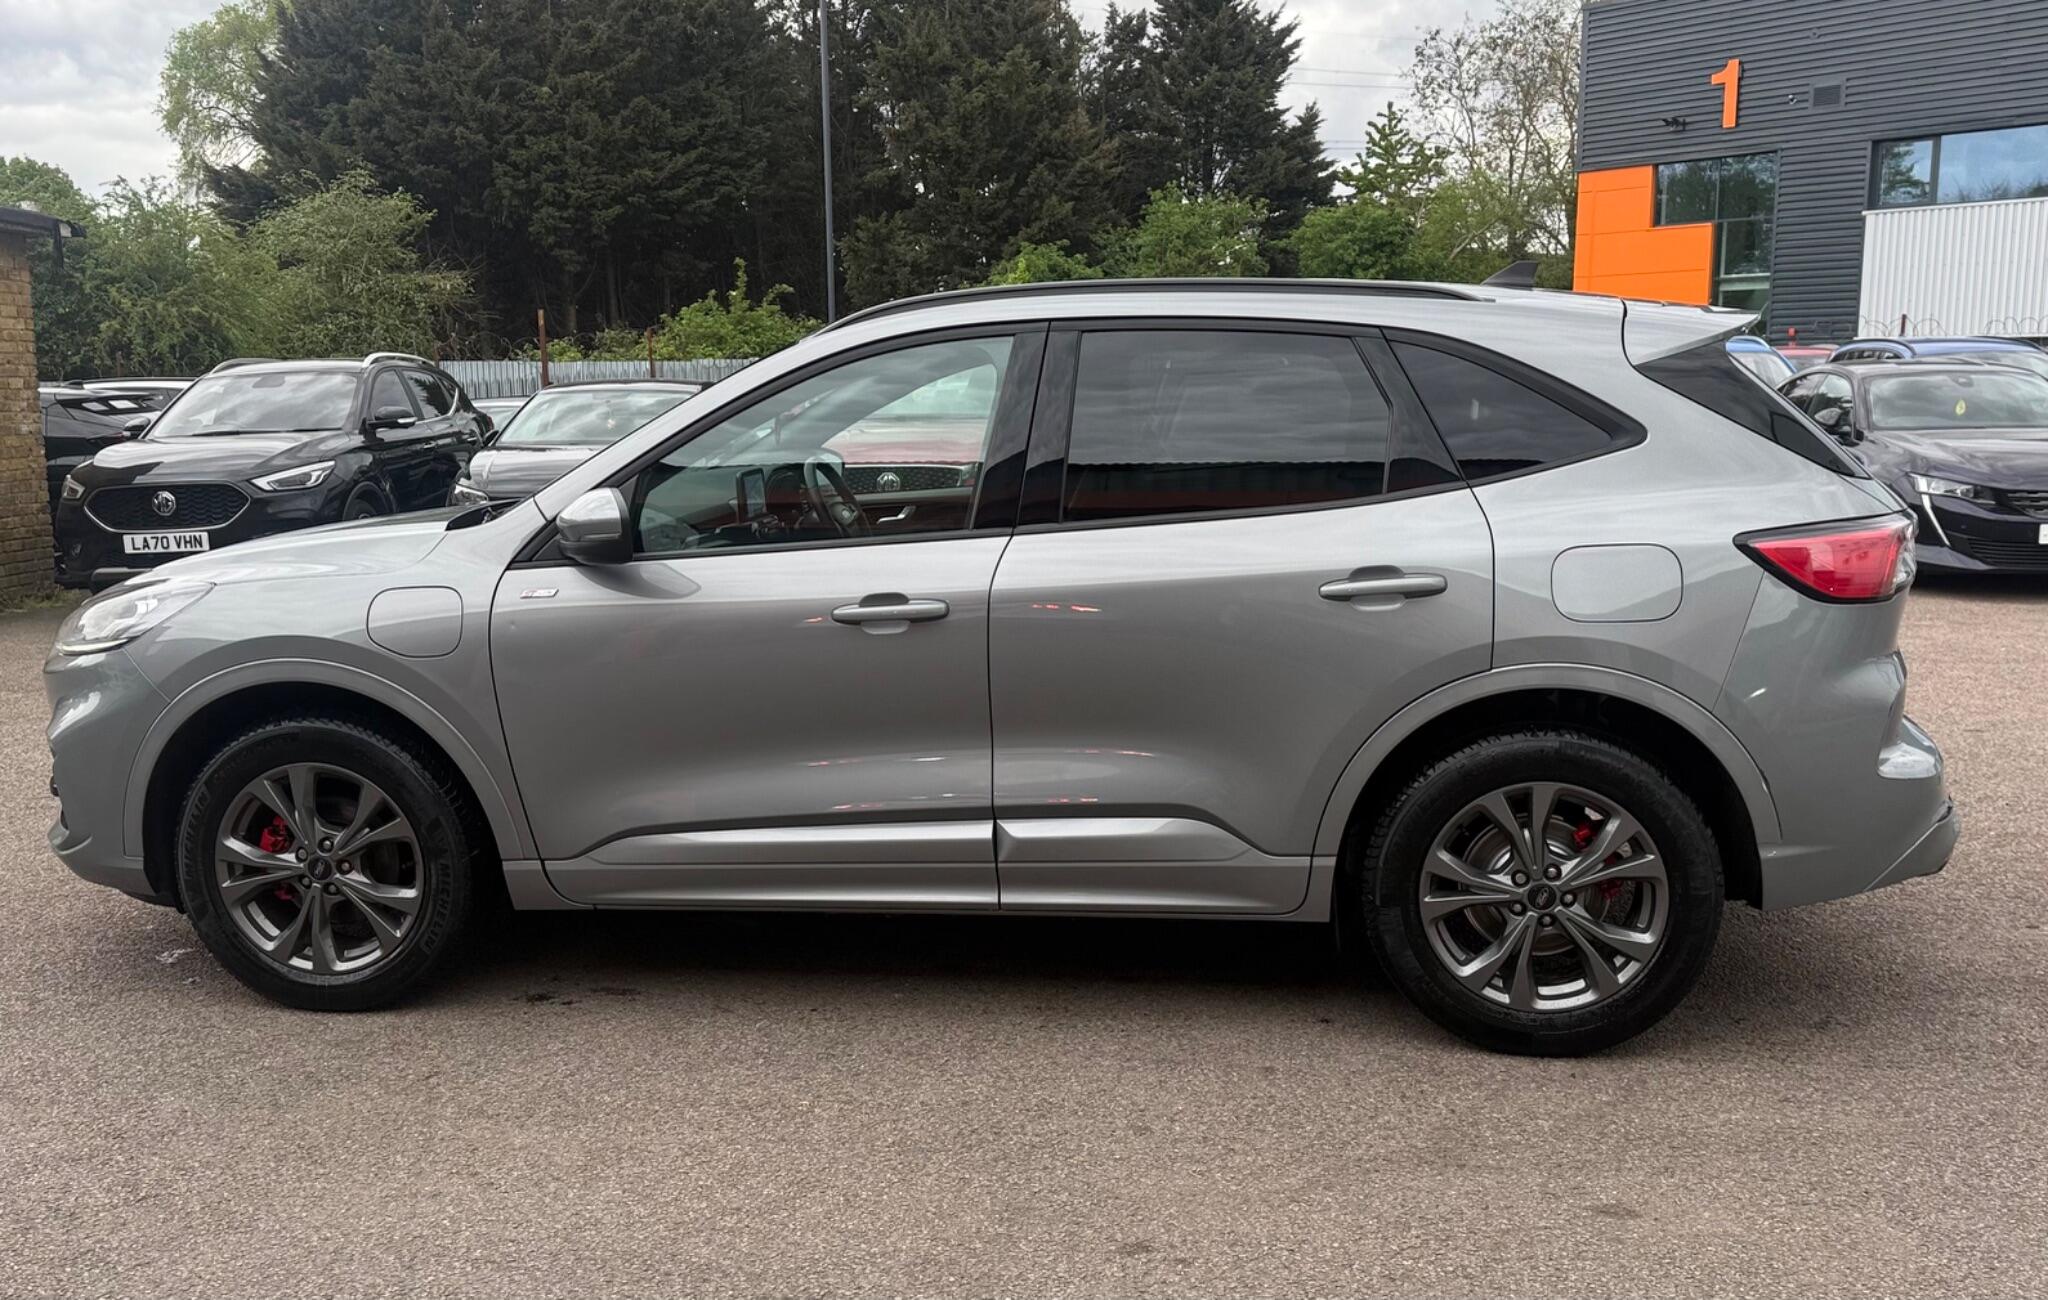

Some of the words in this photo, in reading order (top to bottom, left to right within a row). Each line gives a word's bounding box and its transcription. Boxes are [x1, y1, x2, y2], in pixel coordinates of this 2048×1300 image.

[1711, 58, 1740, 128] 1
[130, 535, 170, 551] LA70
[173, 533, 203, 549] VHN
